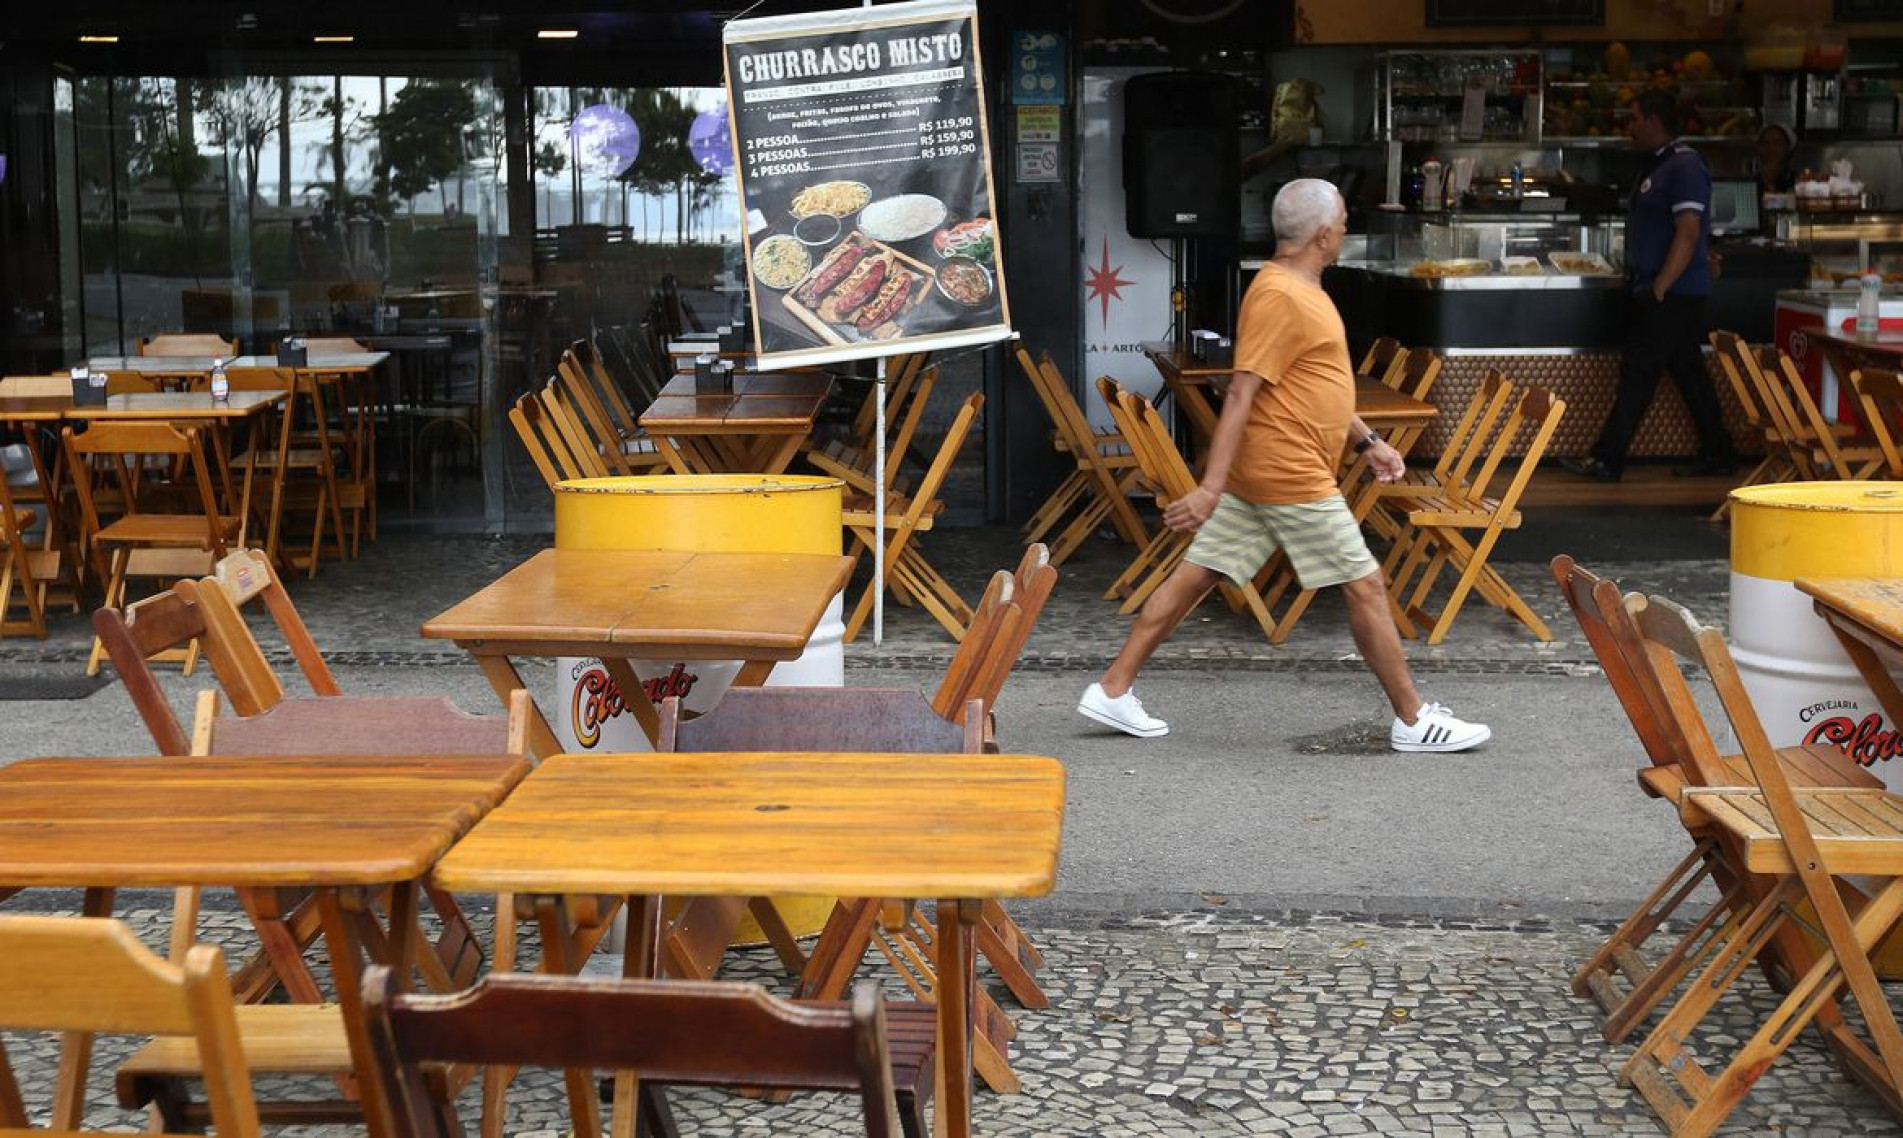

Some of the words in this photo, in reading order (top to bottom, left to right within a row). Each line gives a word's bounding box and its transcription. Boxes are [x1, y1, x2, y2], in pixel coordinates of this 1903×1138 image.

[739, 42, 881, 84] CHURRASCO
[888, 33, 962, 68] MISTO
[746, 140, 754, 150] 2
[918, 120, 933, 133] R$
[935, 116, 973, 130] 119,90
[748, 153, 756, 165] 3
[920, 134, 935, 146] R$
[936, 129, 974, 143] 159,90
[750, 168, 759, 178] 4
[921, 147, 936, 159] R$
[938, 142, 976, 157] 199,90
[572, 662, 699, 749] Coloado
[1798, 700, 1858, 723] CERVEJARIA
